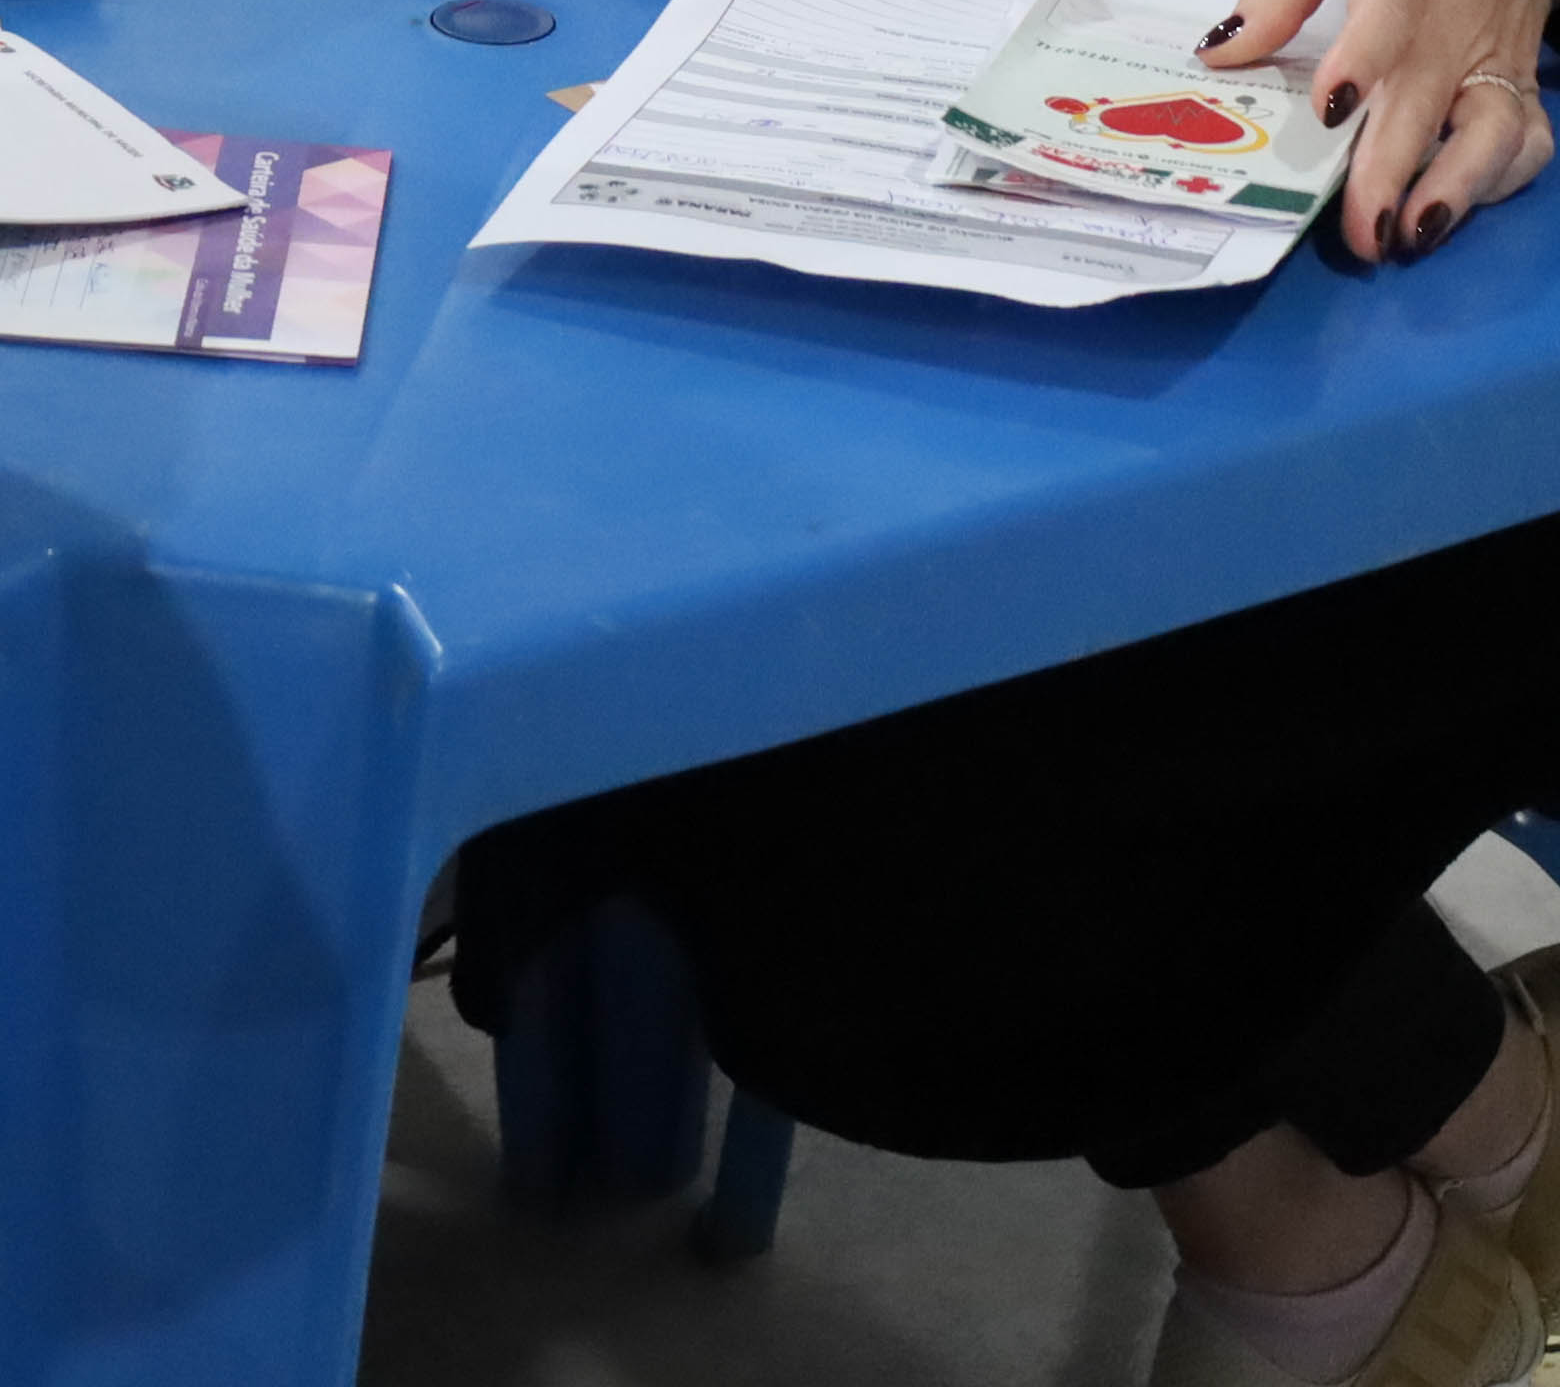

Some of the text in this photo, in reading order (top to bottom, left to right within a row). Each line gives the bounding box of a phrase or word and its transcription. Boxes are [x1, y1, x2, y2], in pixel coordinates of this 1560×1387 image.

[247, 151, 280, 198] Carteira
[235, 214, 267, 253] Saúde
[232, 253, 259, 271] da
[222, 270, 257, 315] Mulher
